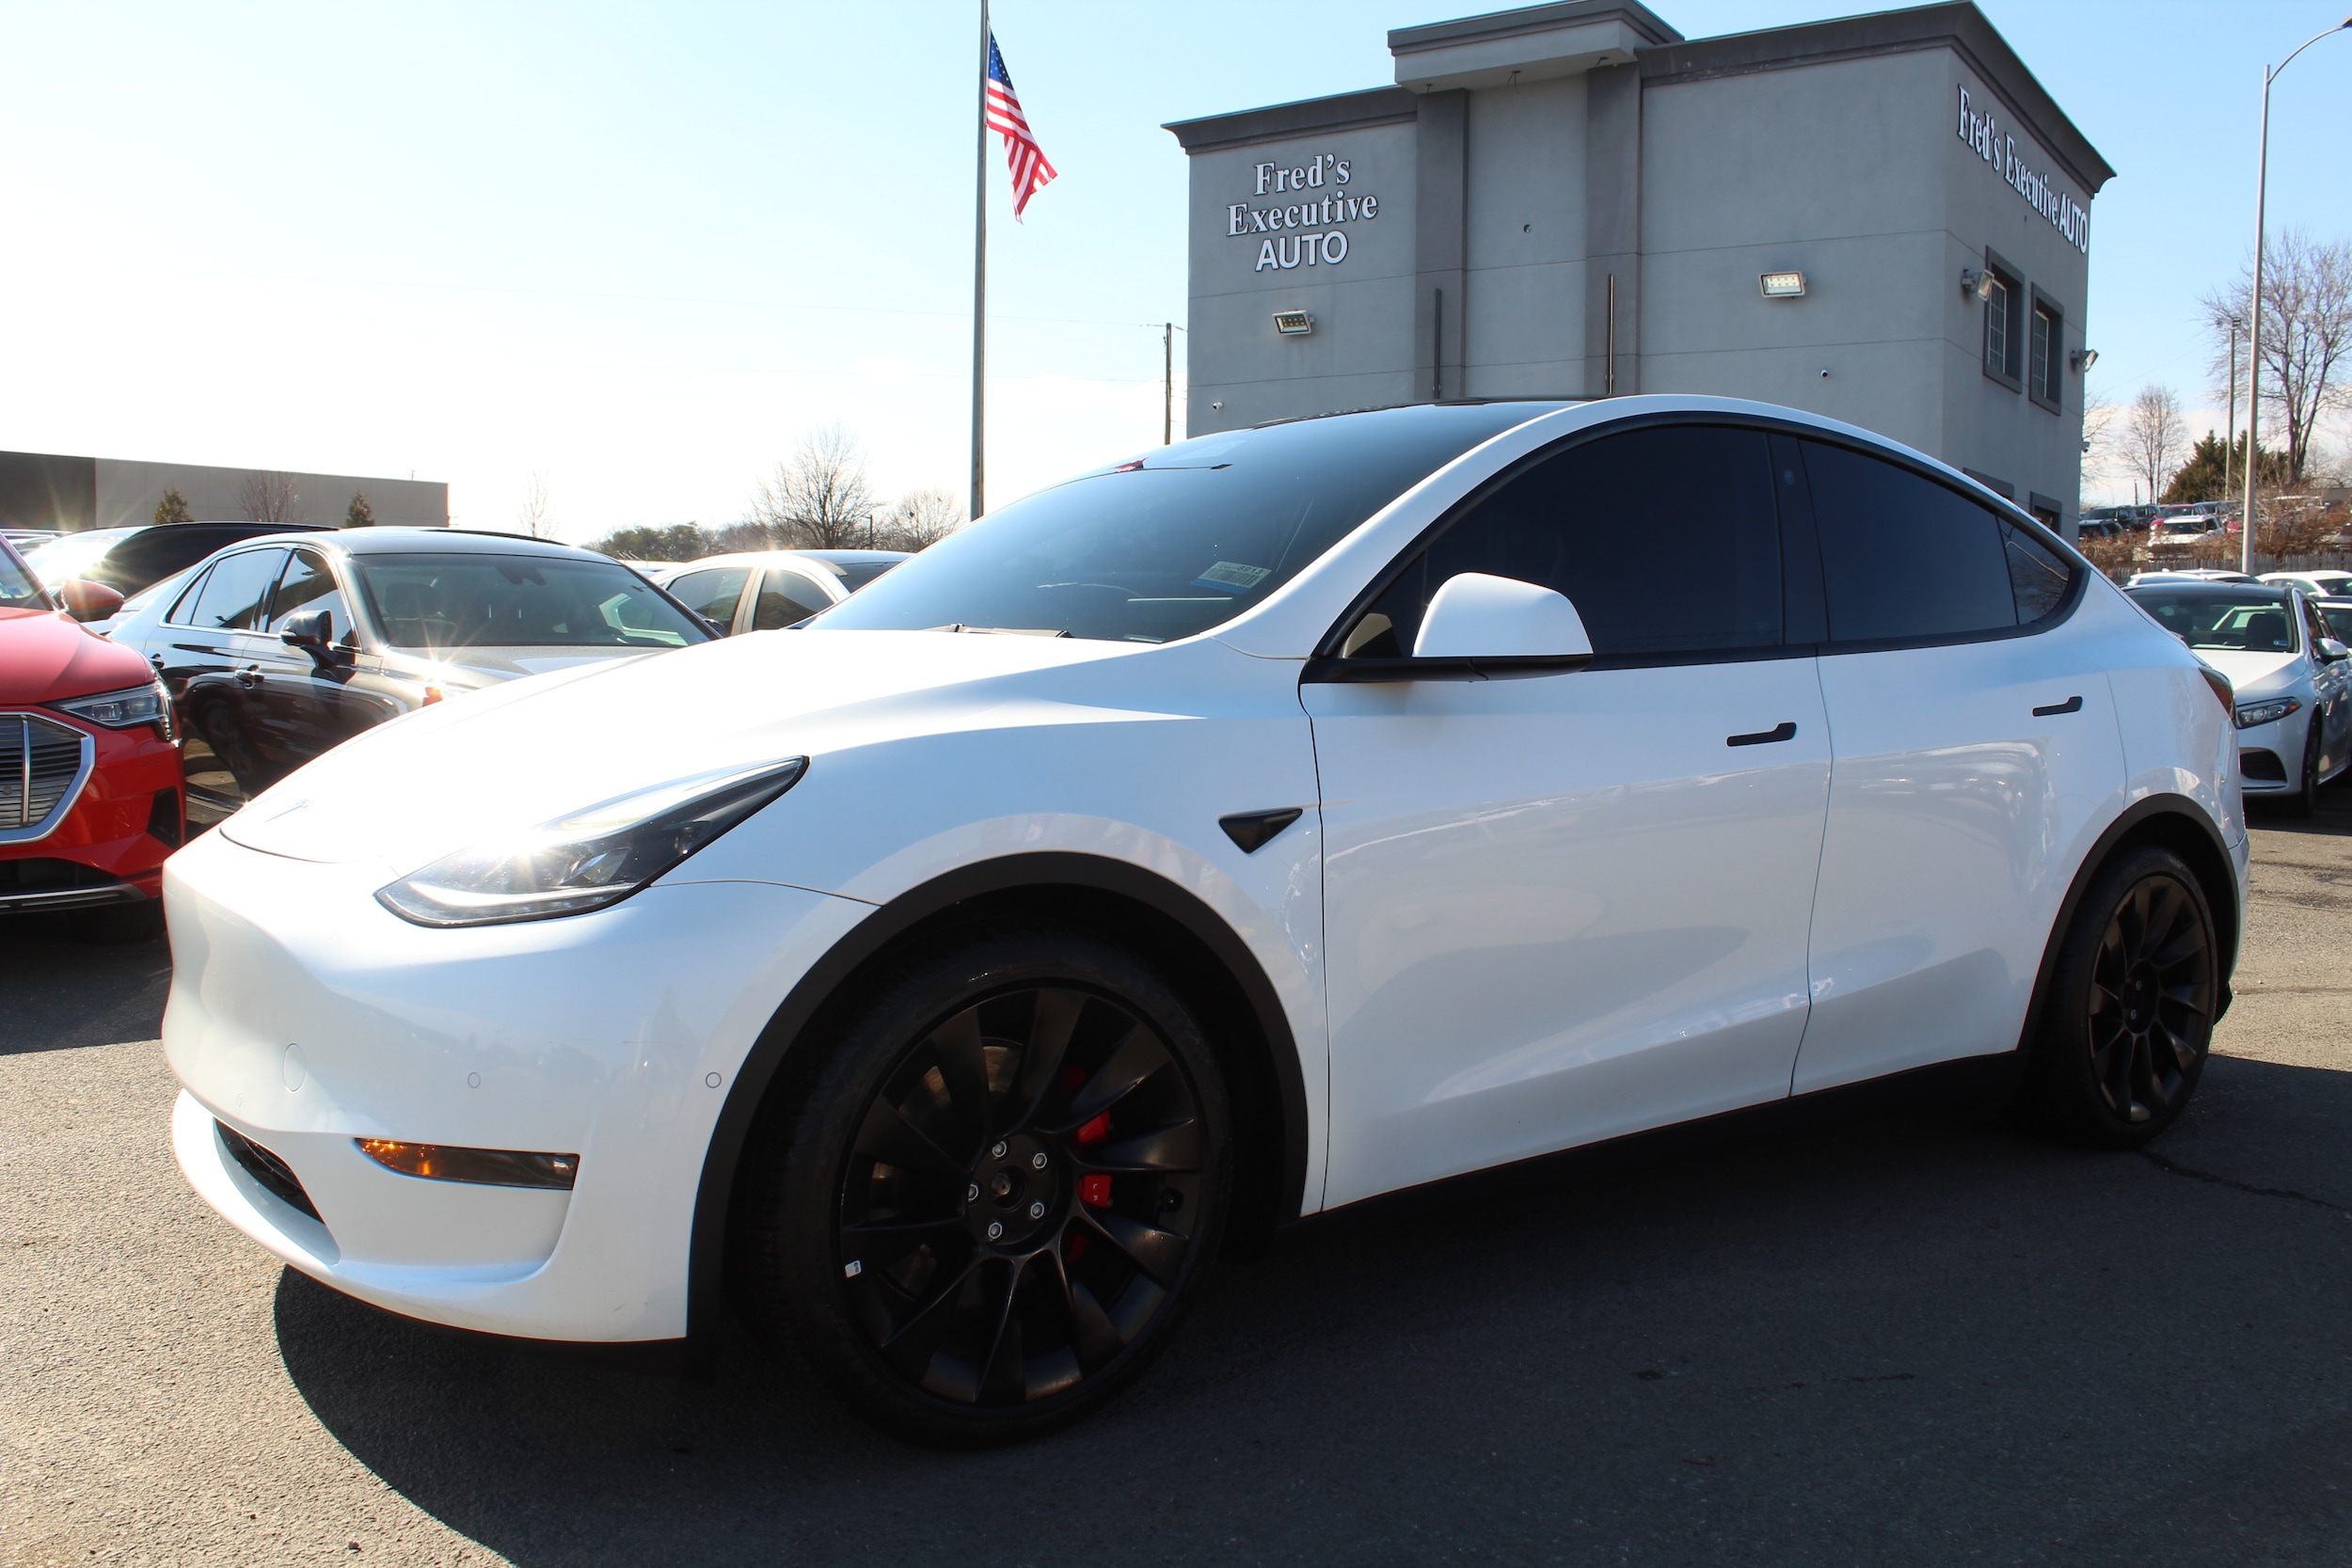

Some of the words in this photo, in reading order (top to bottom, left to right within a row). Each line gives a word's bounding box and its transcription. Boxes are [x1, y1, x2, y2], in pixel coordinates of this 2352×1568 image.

[1253, 153, 1351, 196] Fred's
[1958, 84, 2000, 171] Fred's
[2004, 132, 2058, 227] Executive
[2058, 191, 2089, 254] AUTO
[1226, 190, 1378, 236] Executive
[1255, 230, 1348, 271] AUTO
